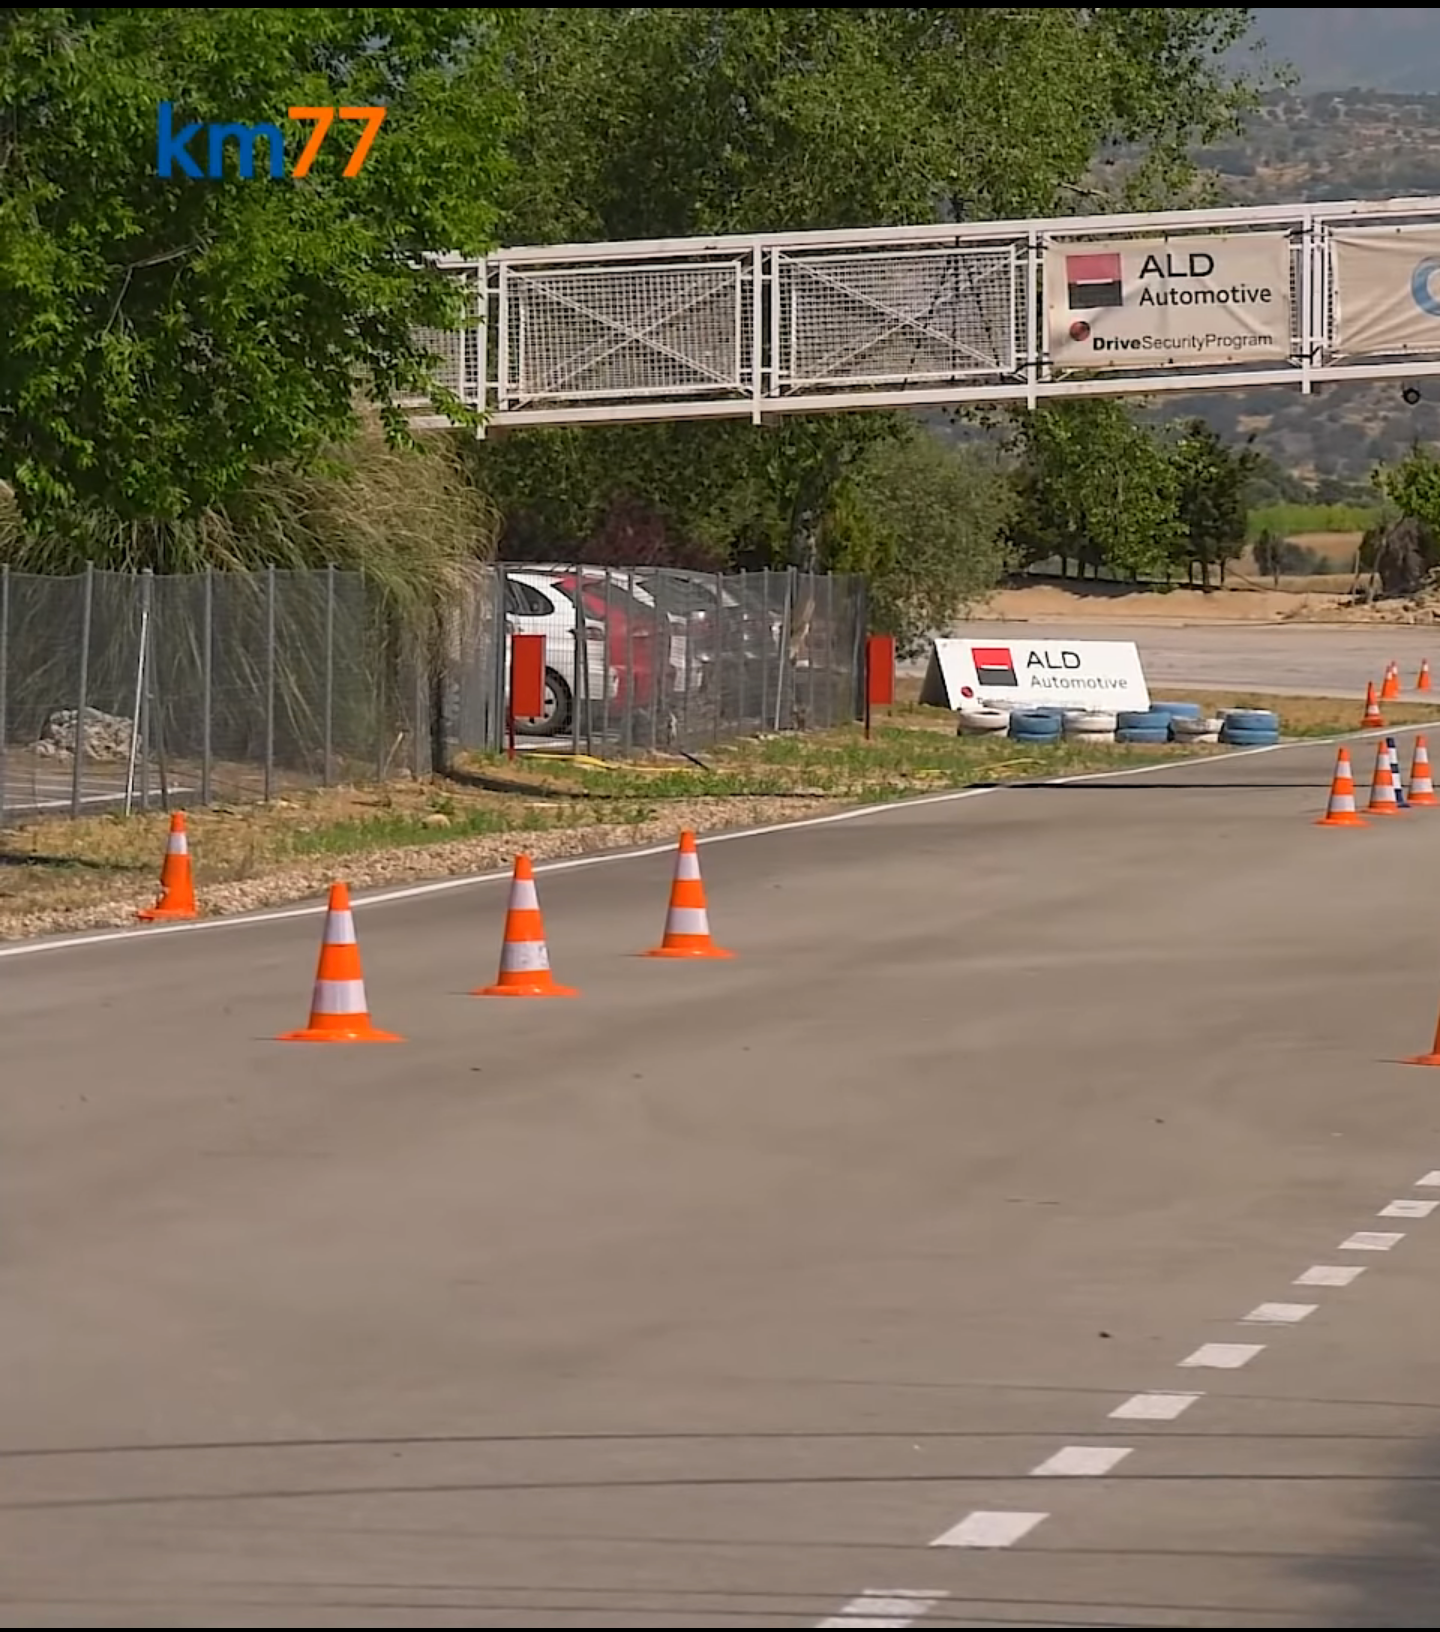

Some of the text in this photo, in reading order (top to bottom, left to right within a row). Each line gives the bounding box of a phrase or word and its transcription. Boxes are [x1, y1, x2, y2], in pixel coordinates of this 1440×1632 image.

[1139, 253, 1214, 279] ALD
[1138, 284, 1272, 307] Automotive
[1026, 651, 1081, 669] ALD
[1031, 675, 1127, 690] Automotive
